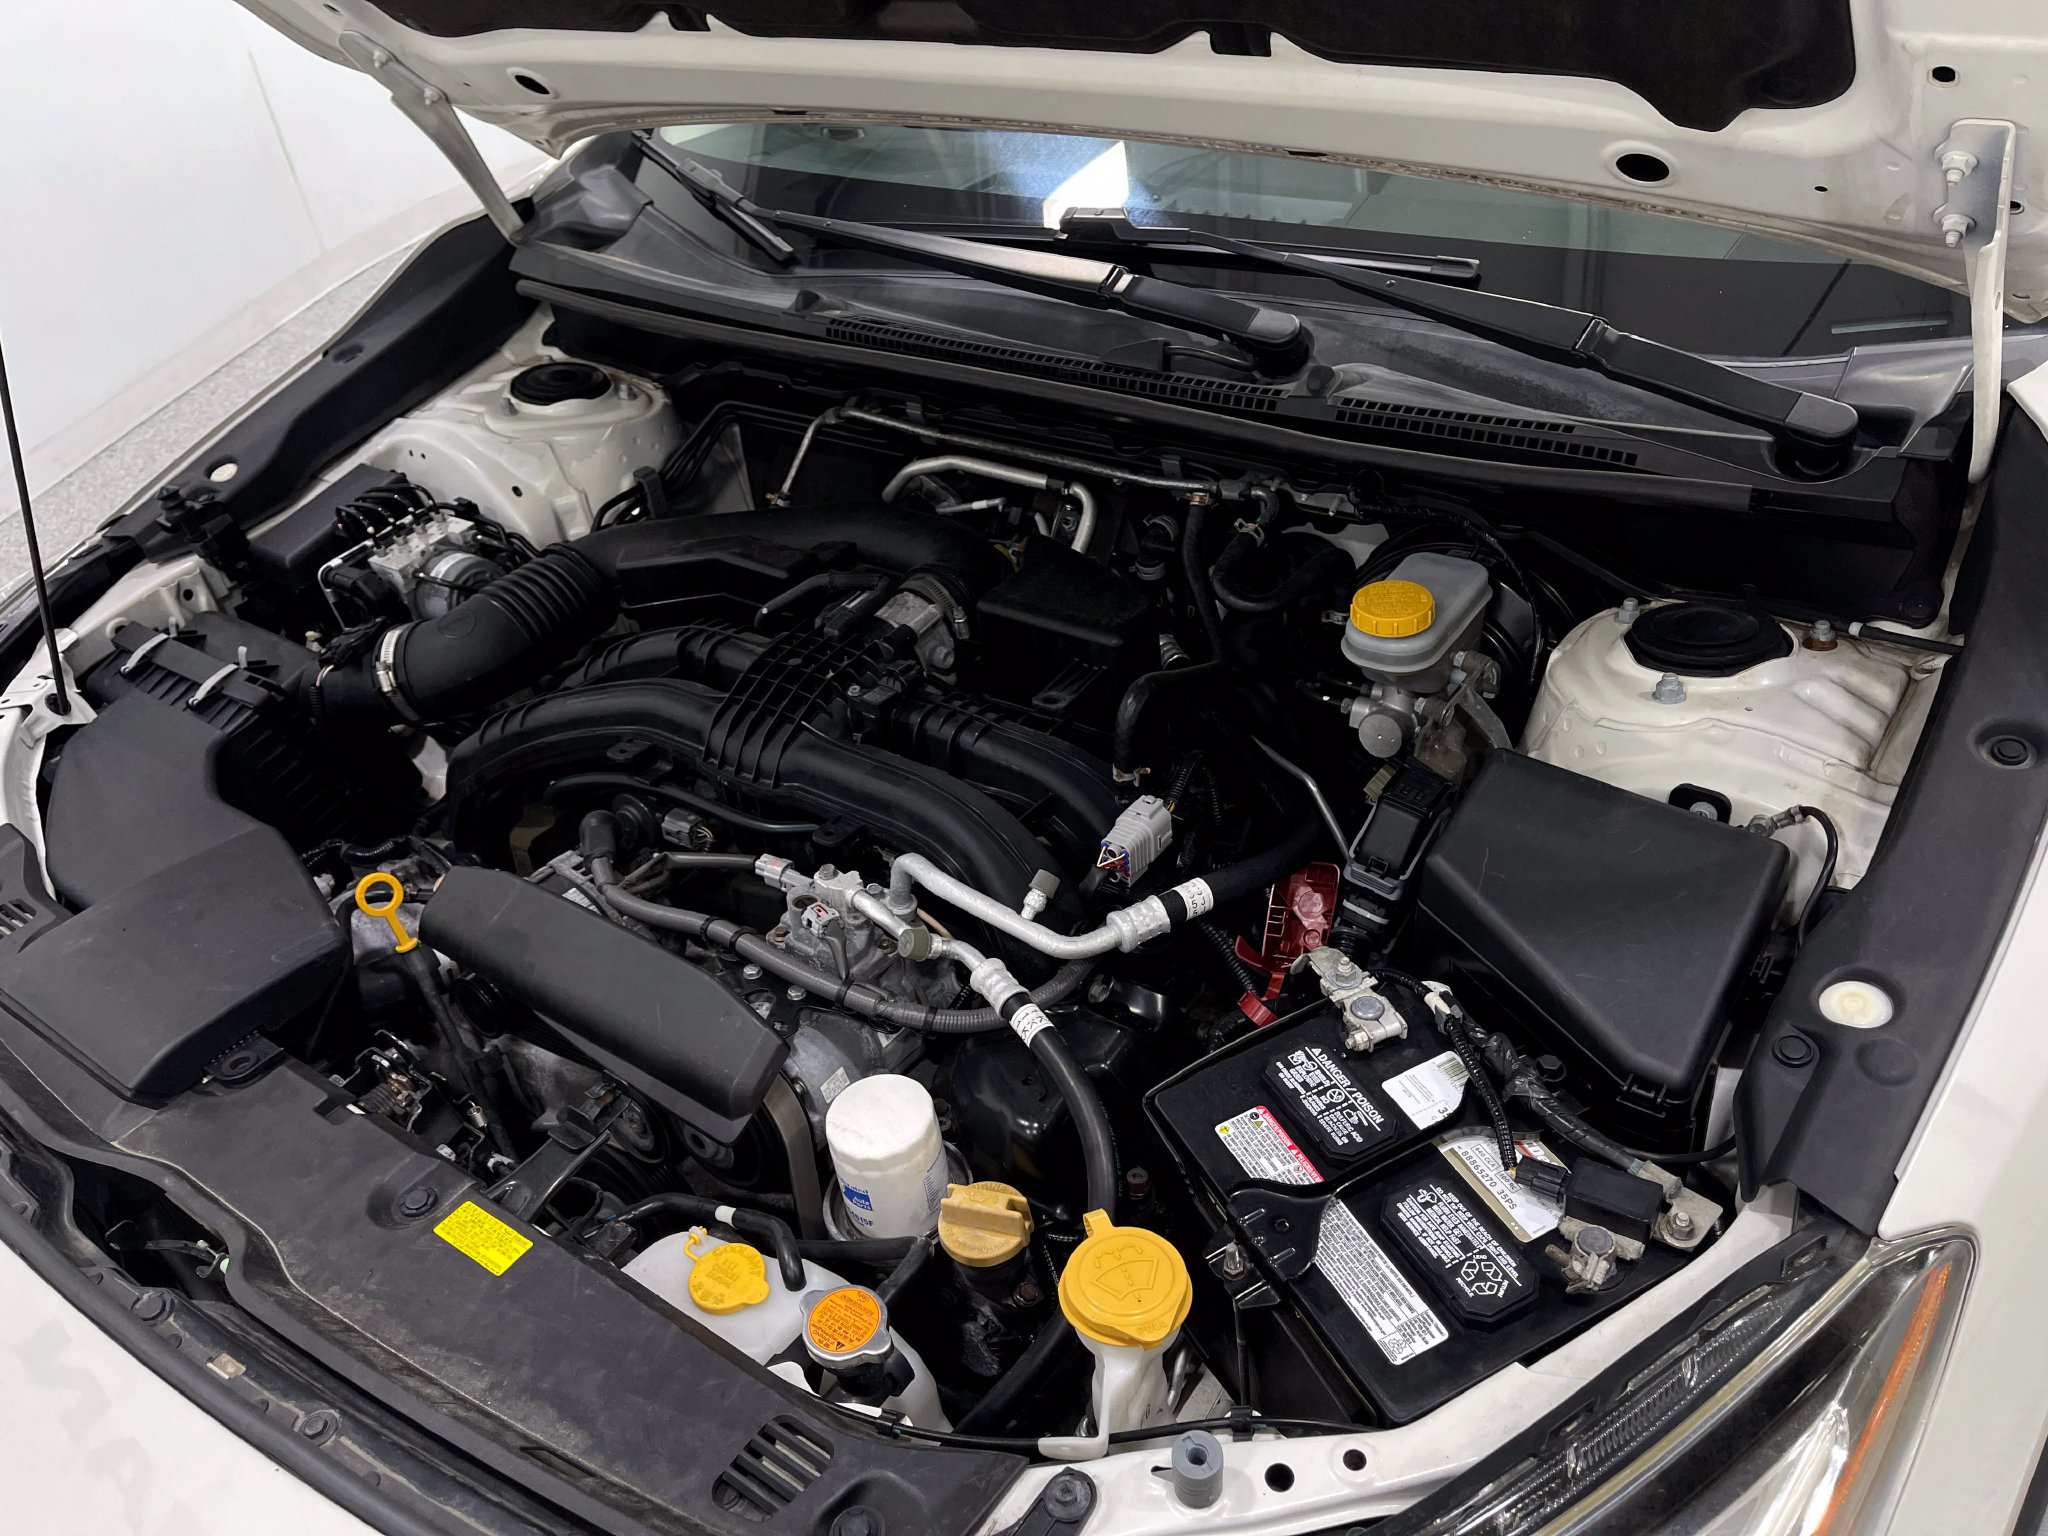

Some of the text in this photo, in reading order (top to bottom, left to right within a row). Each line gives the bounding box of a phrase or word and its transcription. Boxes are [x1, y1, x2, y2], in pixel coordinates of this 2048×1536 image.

[1318, 1054, 1351, 1087] DANGER
[1352, 1092, 1384, 1123] POISON
[1319, 1095, 1330, 1104] NO
[1350, 1131, 1363, 1143] ACID
[1474, 1147, 1496, 1168] 640 CCA
[1461, 1150, 1517, 1210] 88865270 35PS
[1499, 1173, 1517, 1191] 100 RC
[1419, 1213, 1429, 1222] FOR
[1447, 1192, 1460, 1203] KEEP
[1457, 1203, 1467, 1212] OUT
[1470, 1217, 1481, 1227] THE
[1478, 1226, 1493, 1241] REACH
[1490, 1239, 1499, 1247] OF
[1448, 1213, 1461, 1225] EYES
[1440, 1223, 1452, 1234] HELP
[1449, 1233, 1461, 1245] FAST
[1442, 1193, 1452, 1203] NOT
[1457, 1210, 1469, 1221] KEEP
[1466, 1220, 1478, 1232] VENT
[1476, 1231, 1488, 1243] CAPS
[1486, 1242, 1499, 1255] TIGHT
[1498, 1255, 1508, 1265] AND
[1452, 1228, 1463, 1238] GET
[1425, 1236, 1435, 1245] NOT
[713, 1245, 762, 1277] COOLANT
[1455, 1277, 1475, 1298] RECYCLE
